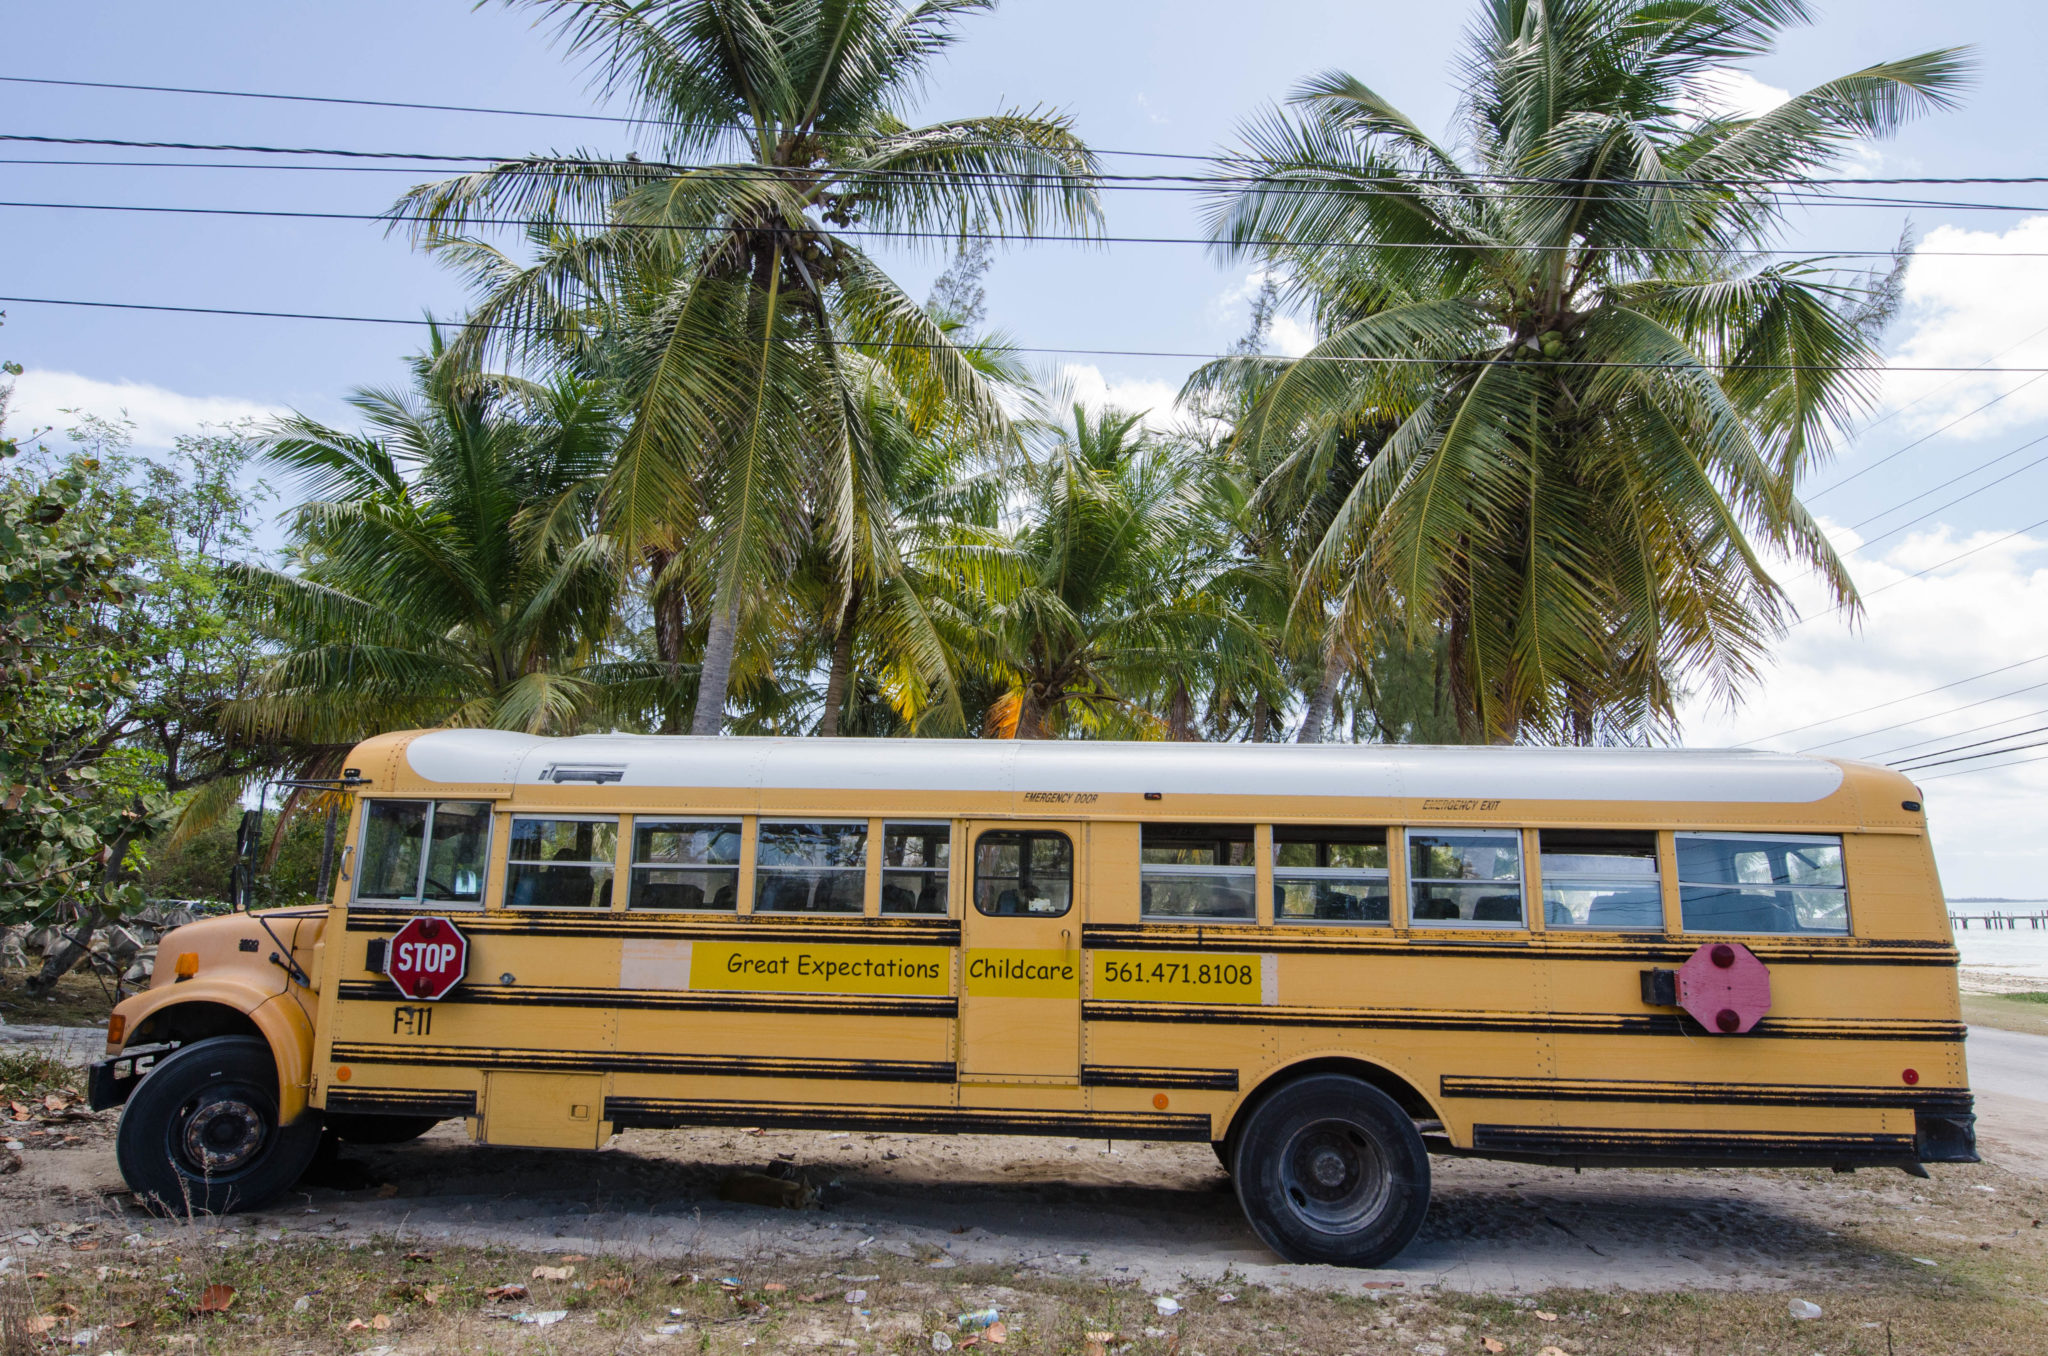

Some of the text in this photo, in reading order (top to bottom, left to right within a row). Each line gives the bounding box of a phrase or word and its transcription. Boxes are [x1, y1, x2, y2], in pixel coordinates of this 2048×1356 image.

[1023, 792, 1099, 804] EMERGENCY DOOR
[1479, 800, 1502, 811] EXIT
[398, 942, 456, 973] STOP
[727, 953, 1253, 985] Great Expectations Childcare 561.471.8108
[393, 1007, 432, 1036] F-11
